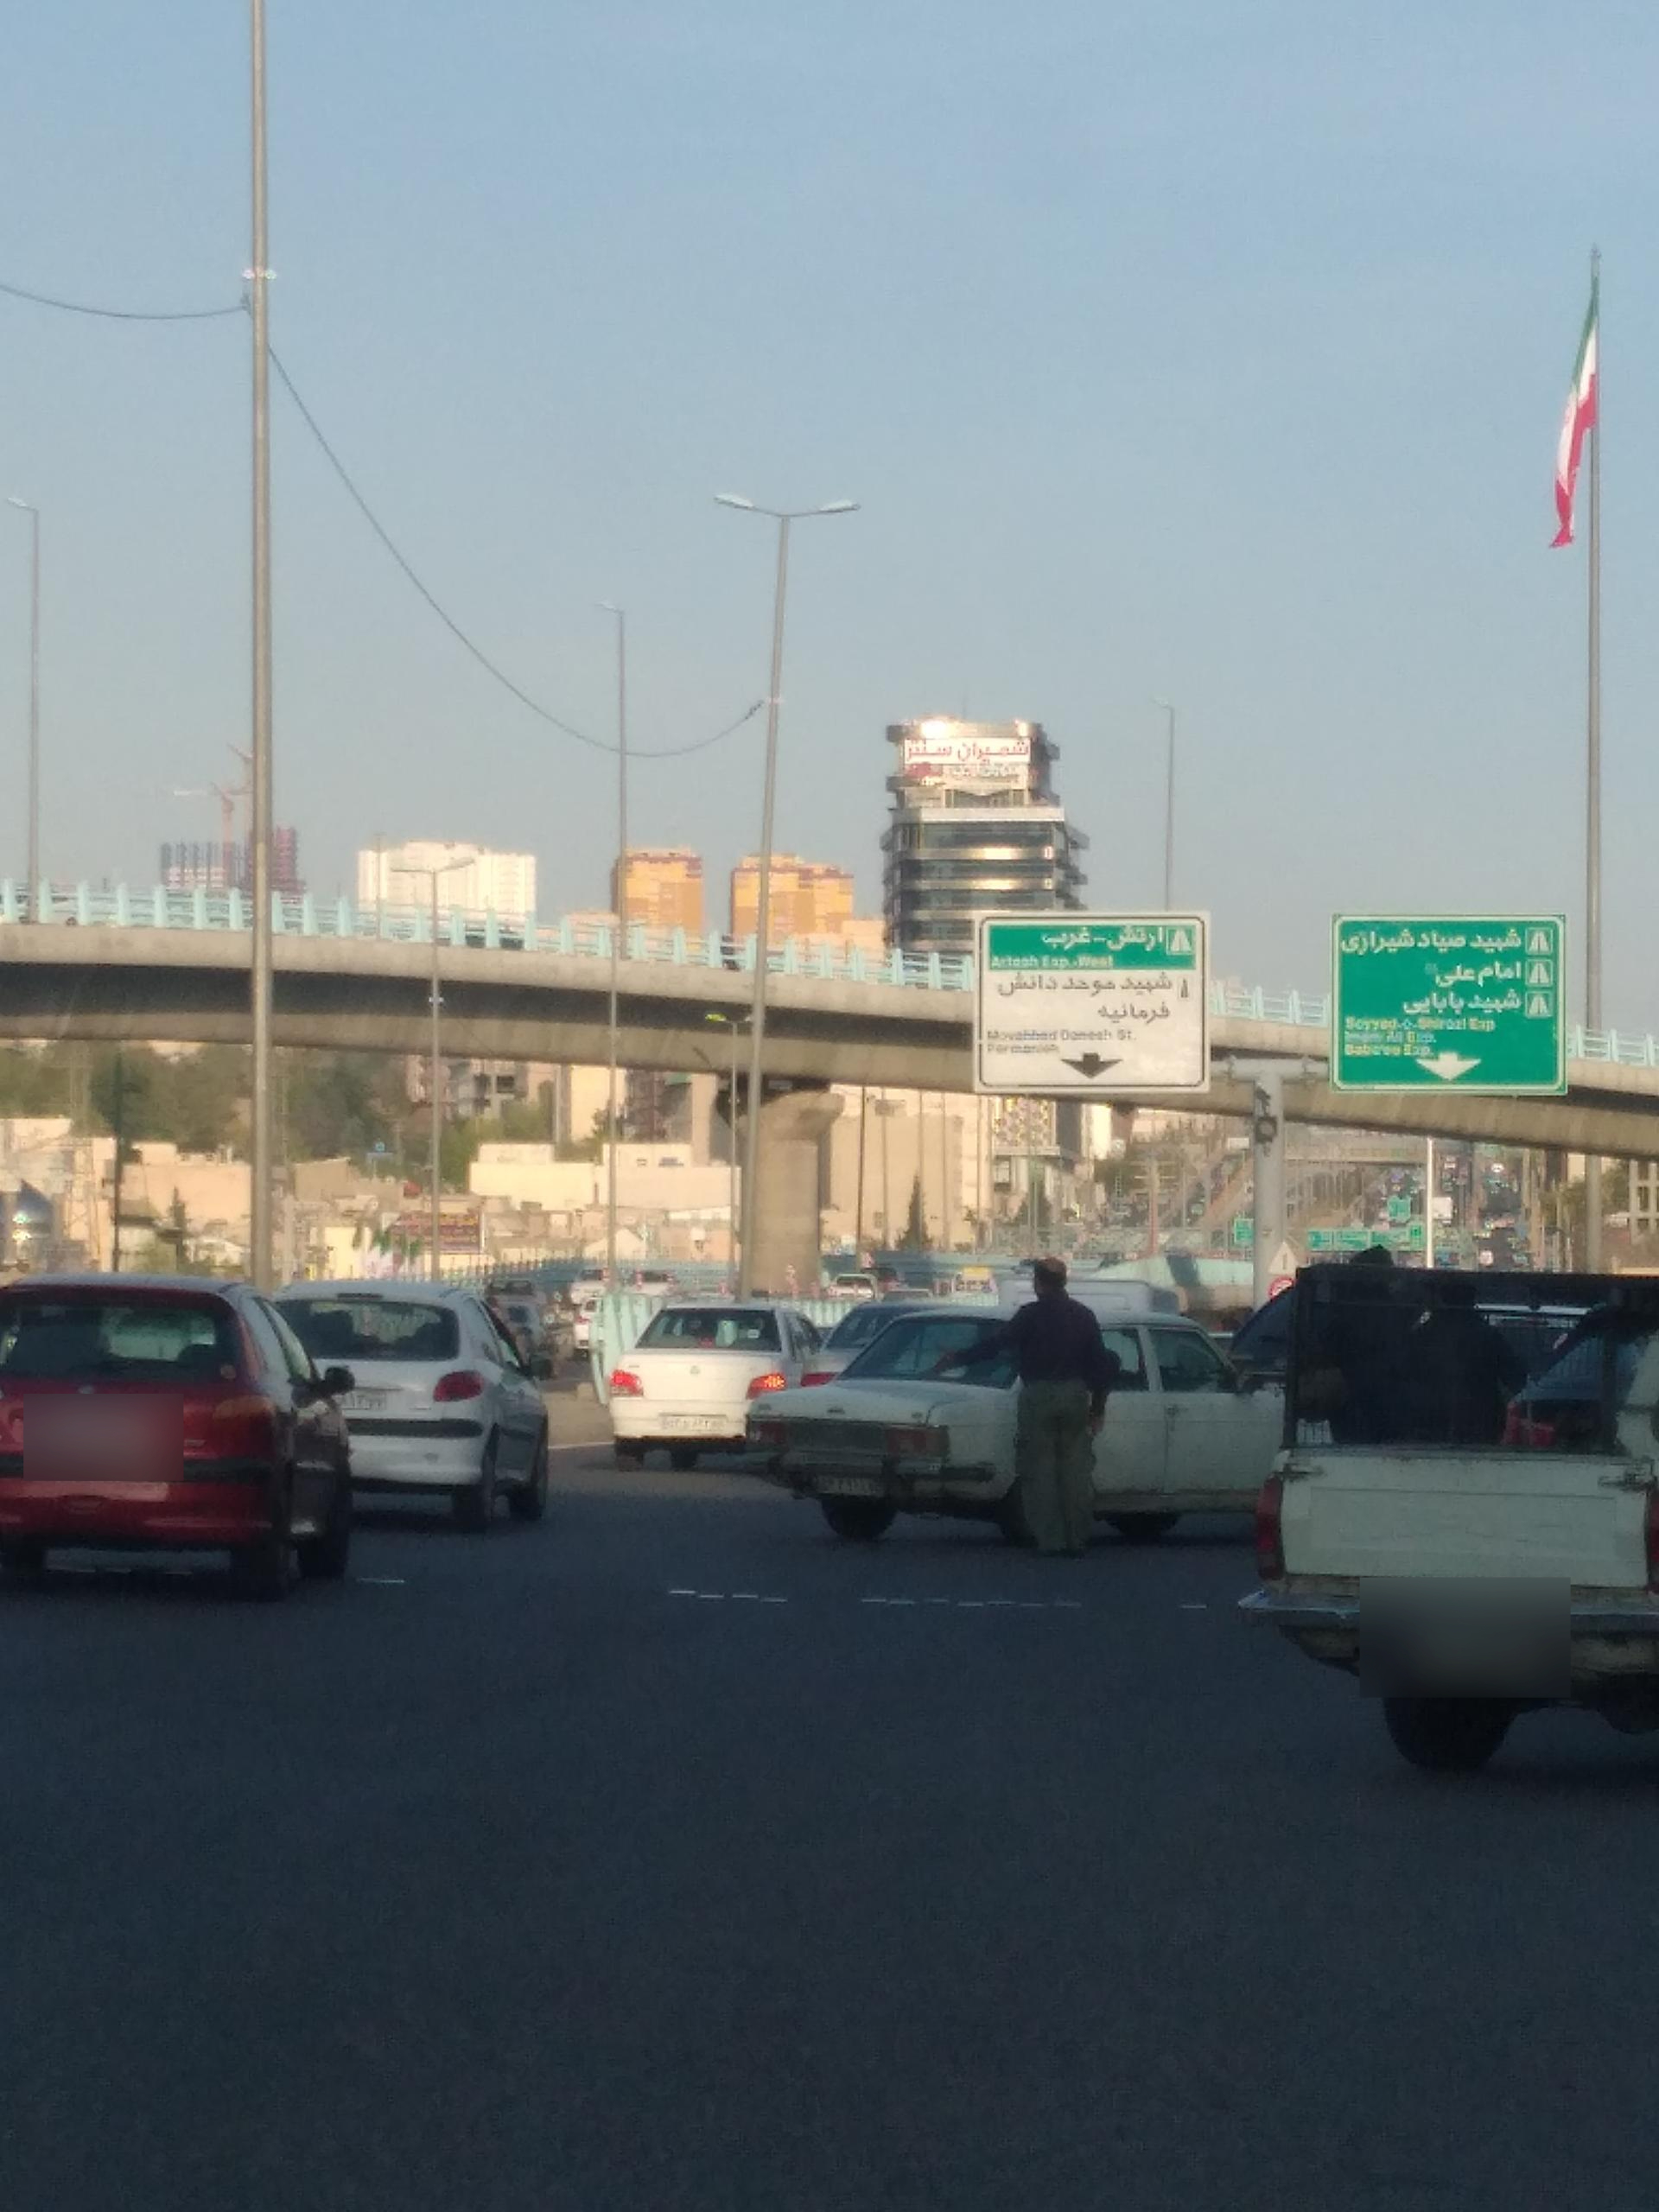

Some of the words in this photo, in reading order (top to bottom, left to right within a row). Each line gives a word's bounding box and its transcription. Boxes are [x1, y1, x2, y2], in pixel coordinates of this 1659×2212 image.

[1341, 928, 1414, 957] شیرازی
[1417, 930, 1466, 954] صیاد
[1469, 928, 1522, 954] شهید
[997, 971, 1057, 996] دانش
[1122, 970, 1172, 996] شهید
[1434, 963, 1476, 988] علی
[1478, 961, 1522, 988] امام
[1097, 1001, 1170, 1024] فرمانیه
[1403, 992, 1465, 1015] بابایی
[1467, 988, 1522, 1014] شهید
